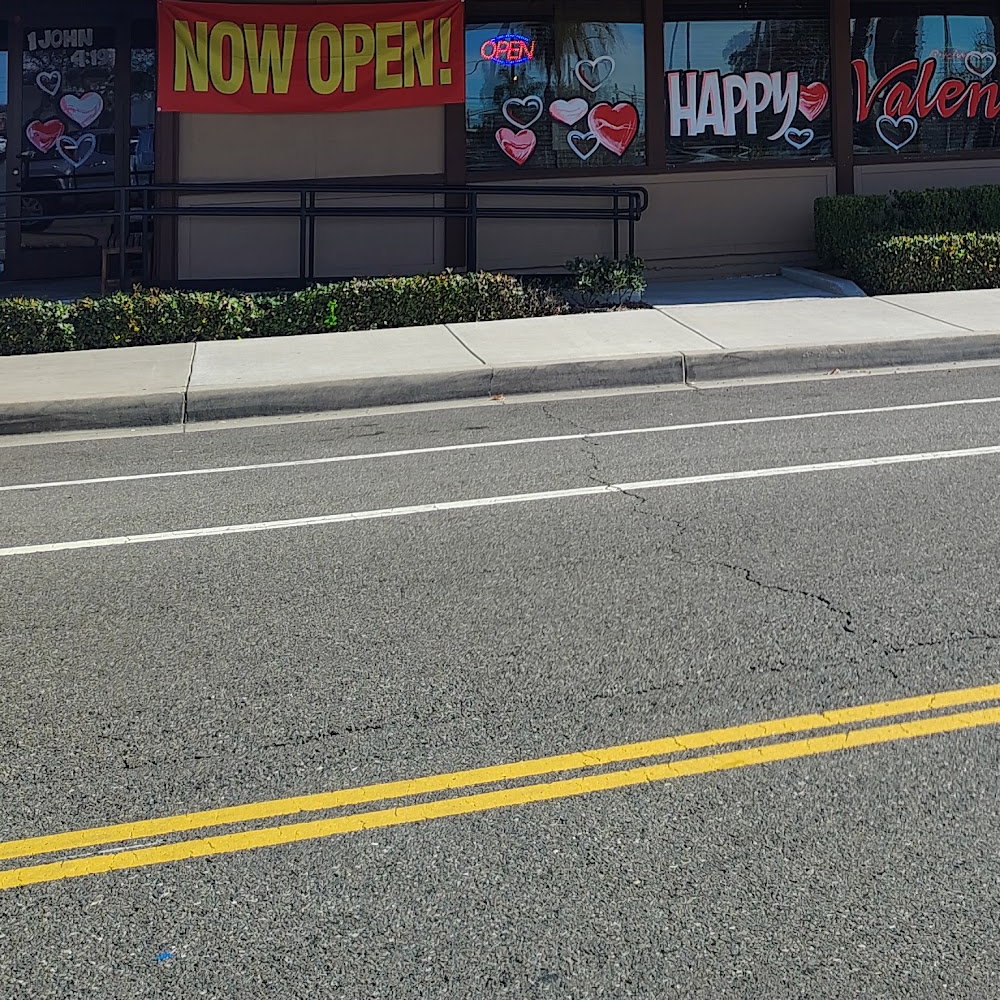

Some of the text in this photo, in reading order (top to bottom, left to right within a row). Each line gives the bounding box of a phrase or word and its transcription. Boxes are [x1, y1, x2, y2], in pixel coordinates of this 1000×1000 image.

[38, 28, 93, 49] JOHN
[173, 17, 453, 95] NOW OPEN!
[480, 40, 536, 60] OPEN
[667, 71, 799, 141] HAPPY
